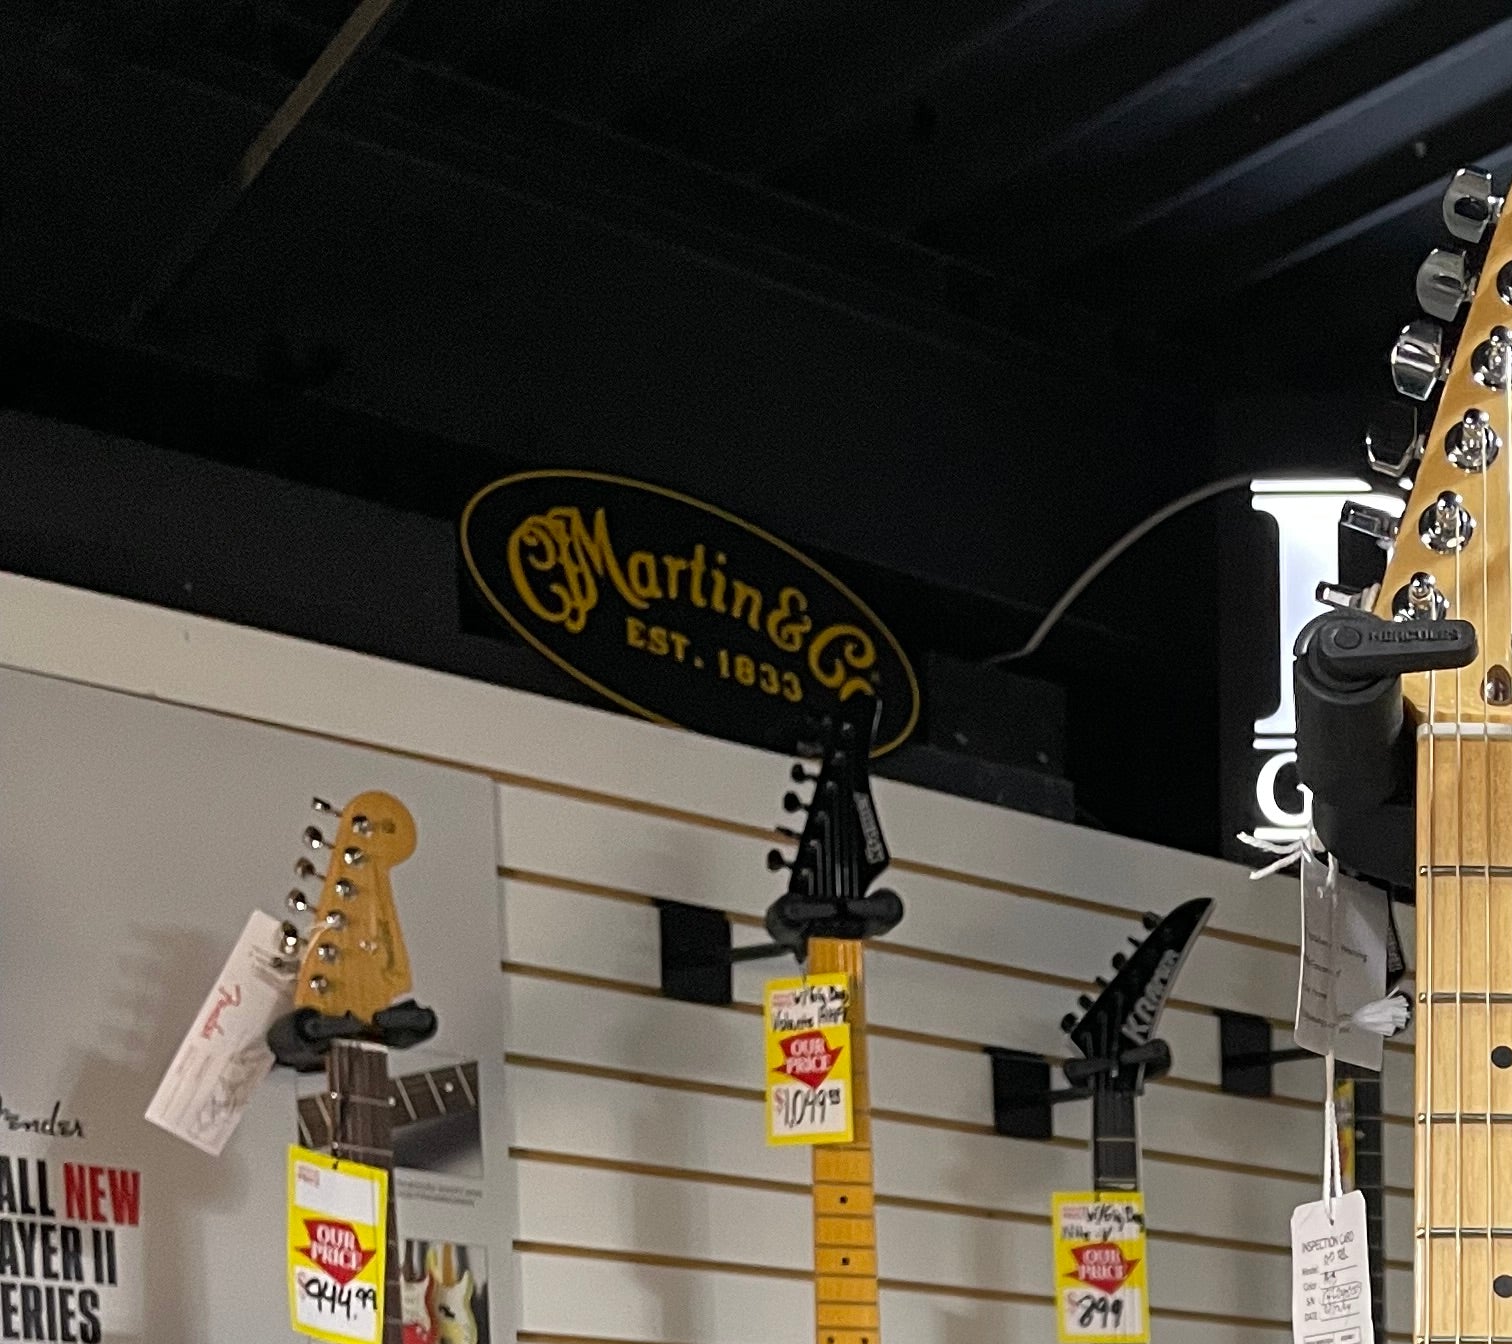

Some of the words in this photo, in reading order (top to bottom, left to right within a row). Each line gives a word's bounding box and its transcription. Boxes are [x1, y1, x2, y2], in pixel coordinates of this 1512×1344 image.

[1368, 627, 1460, 642] HERCULES
[626, 616, 704, 670] EST.
[717, 649, 803, 703] 1833
[789, 1037, 826, 1058] OUR
[0, 1095, 85, 1138] ender
[62, 1161, 141, 1227] NEW
[91, 1228, 118, 1288] II
[315, 1223, 357, 1251] OUR
